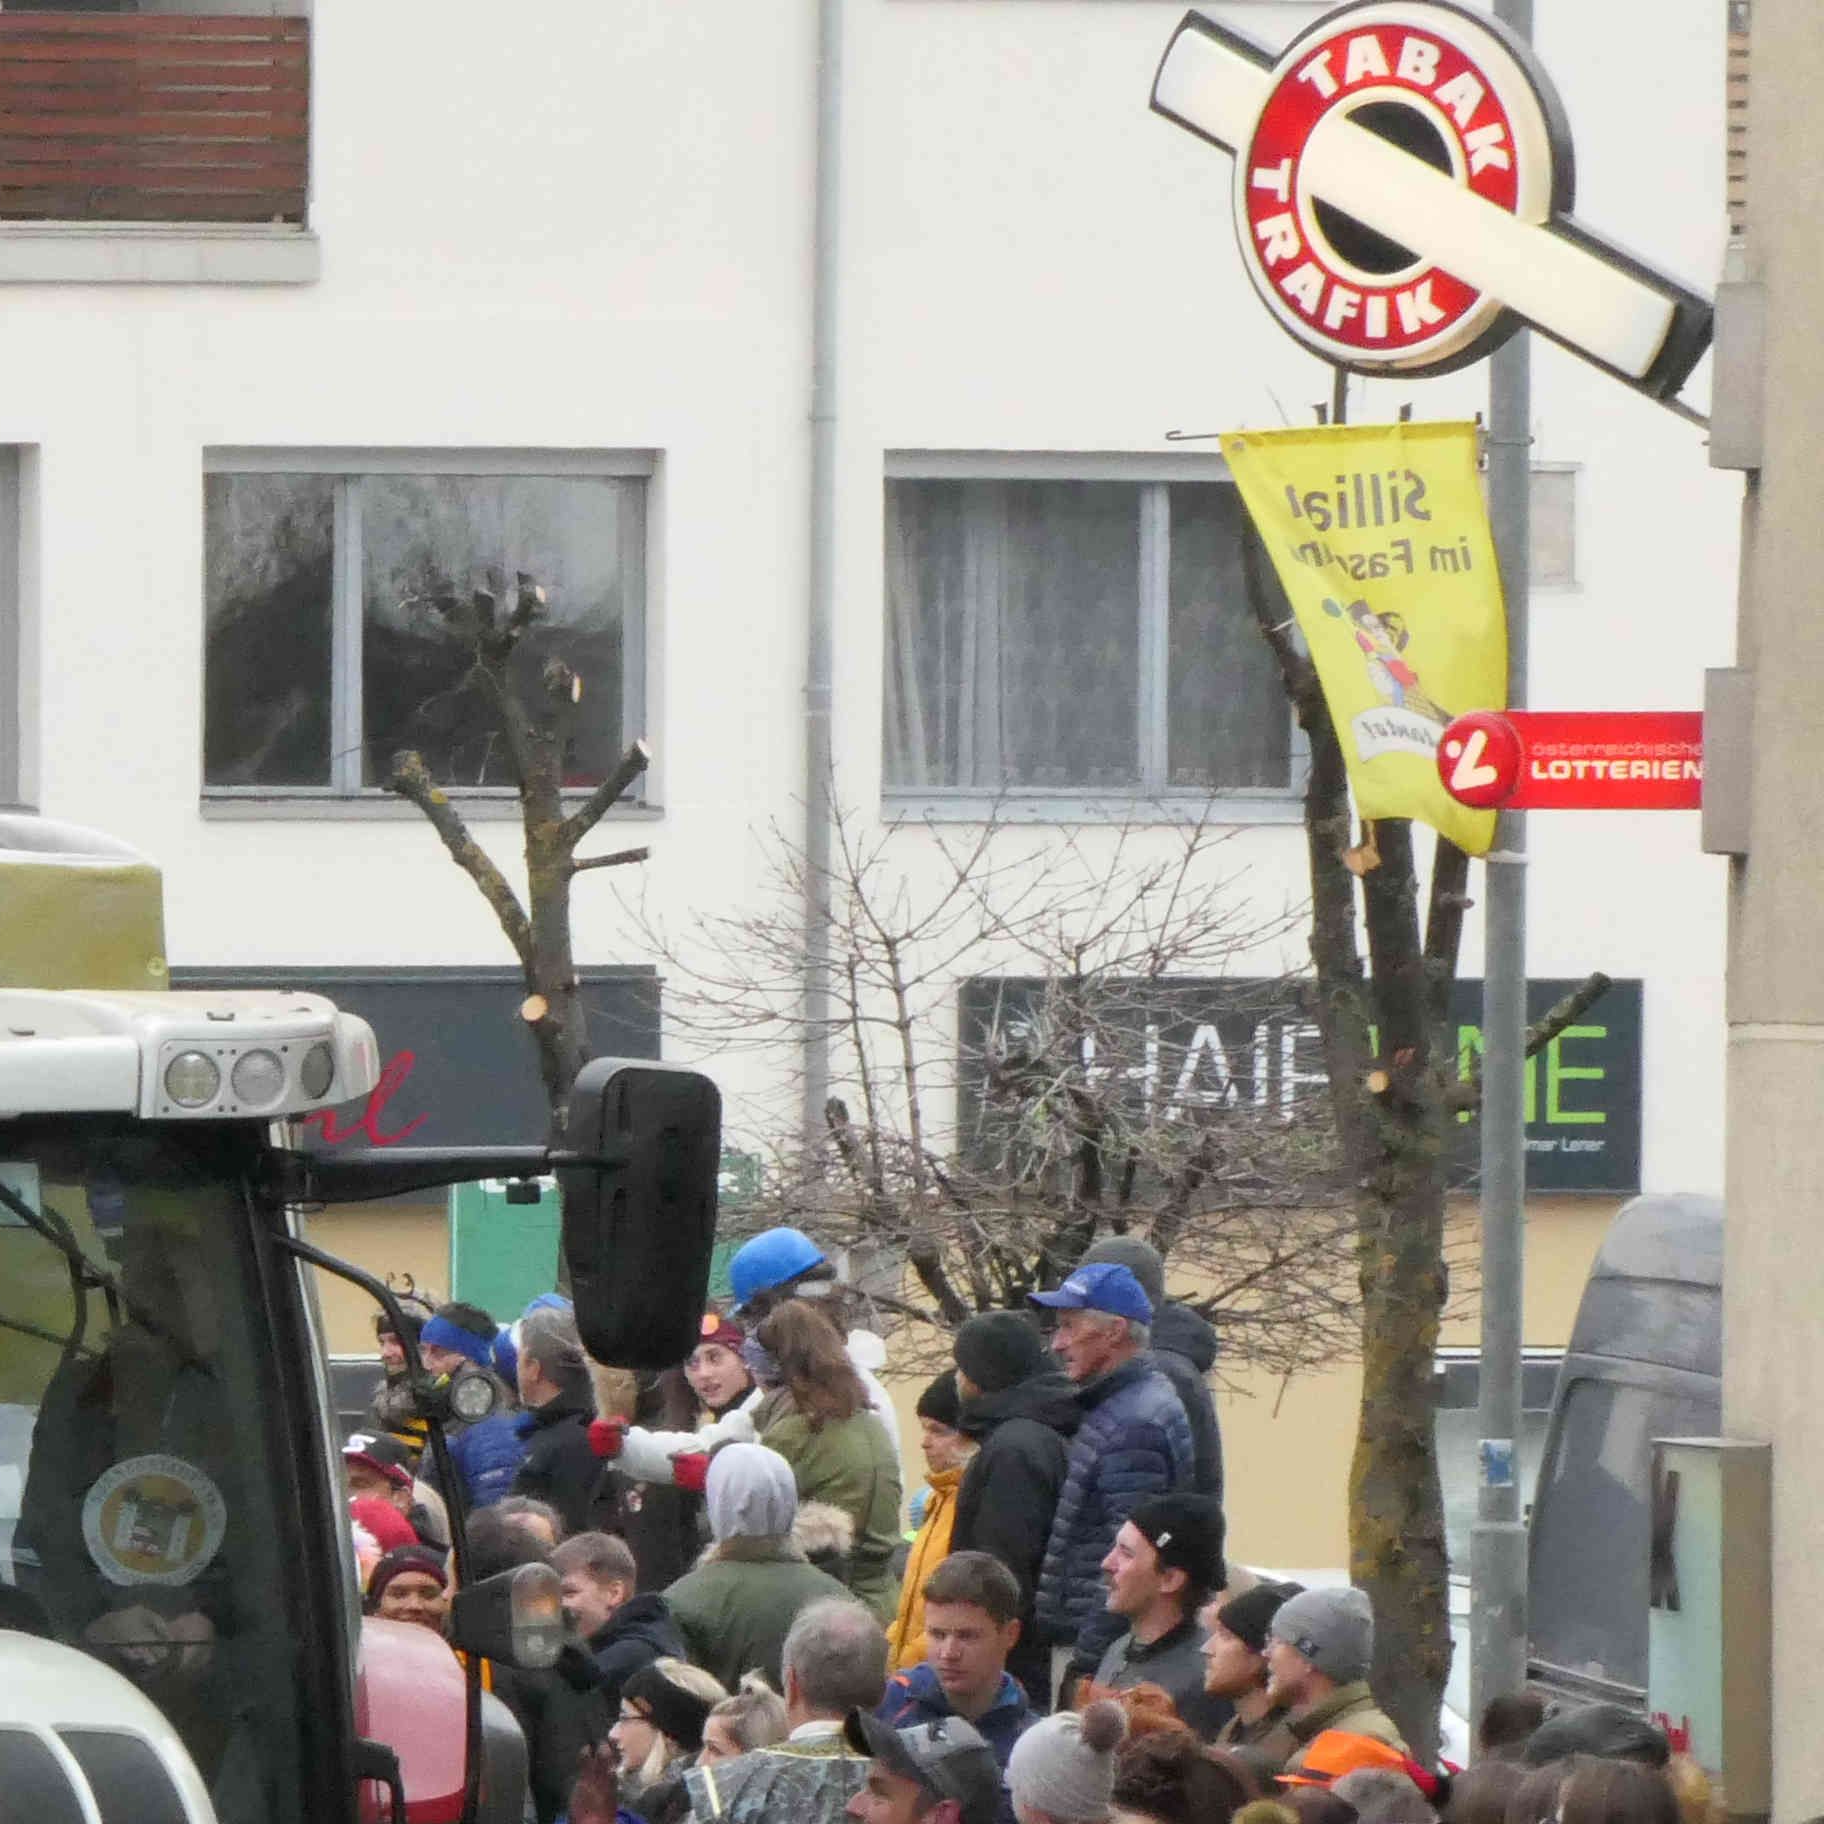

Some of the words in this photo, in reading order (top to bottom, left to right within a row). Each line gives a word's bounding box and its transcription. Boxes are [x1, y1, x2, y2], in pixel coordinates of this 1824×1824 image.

[1296, 33, 1512, 177] TABAK
[1251, 157, 1448, 339] TRAFIK
[1530, 758, 1704, 780] LOTTERIEN
